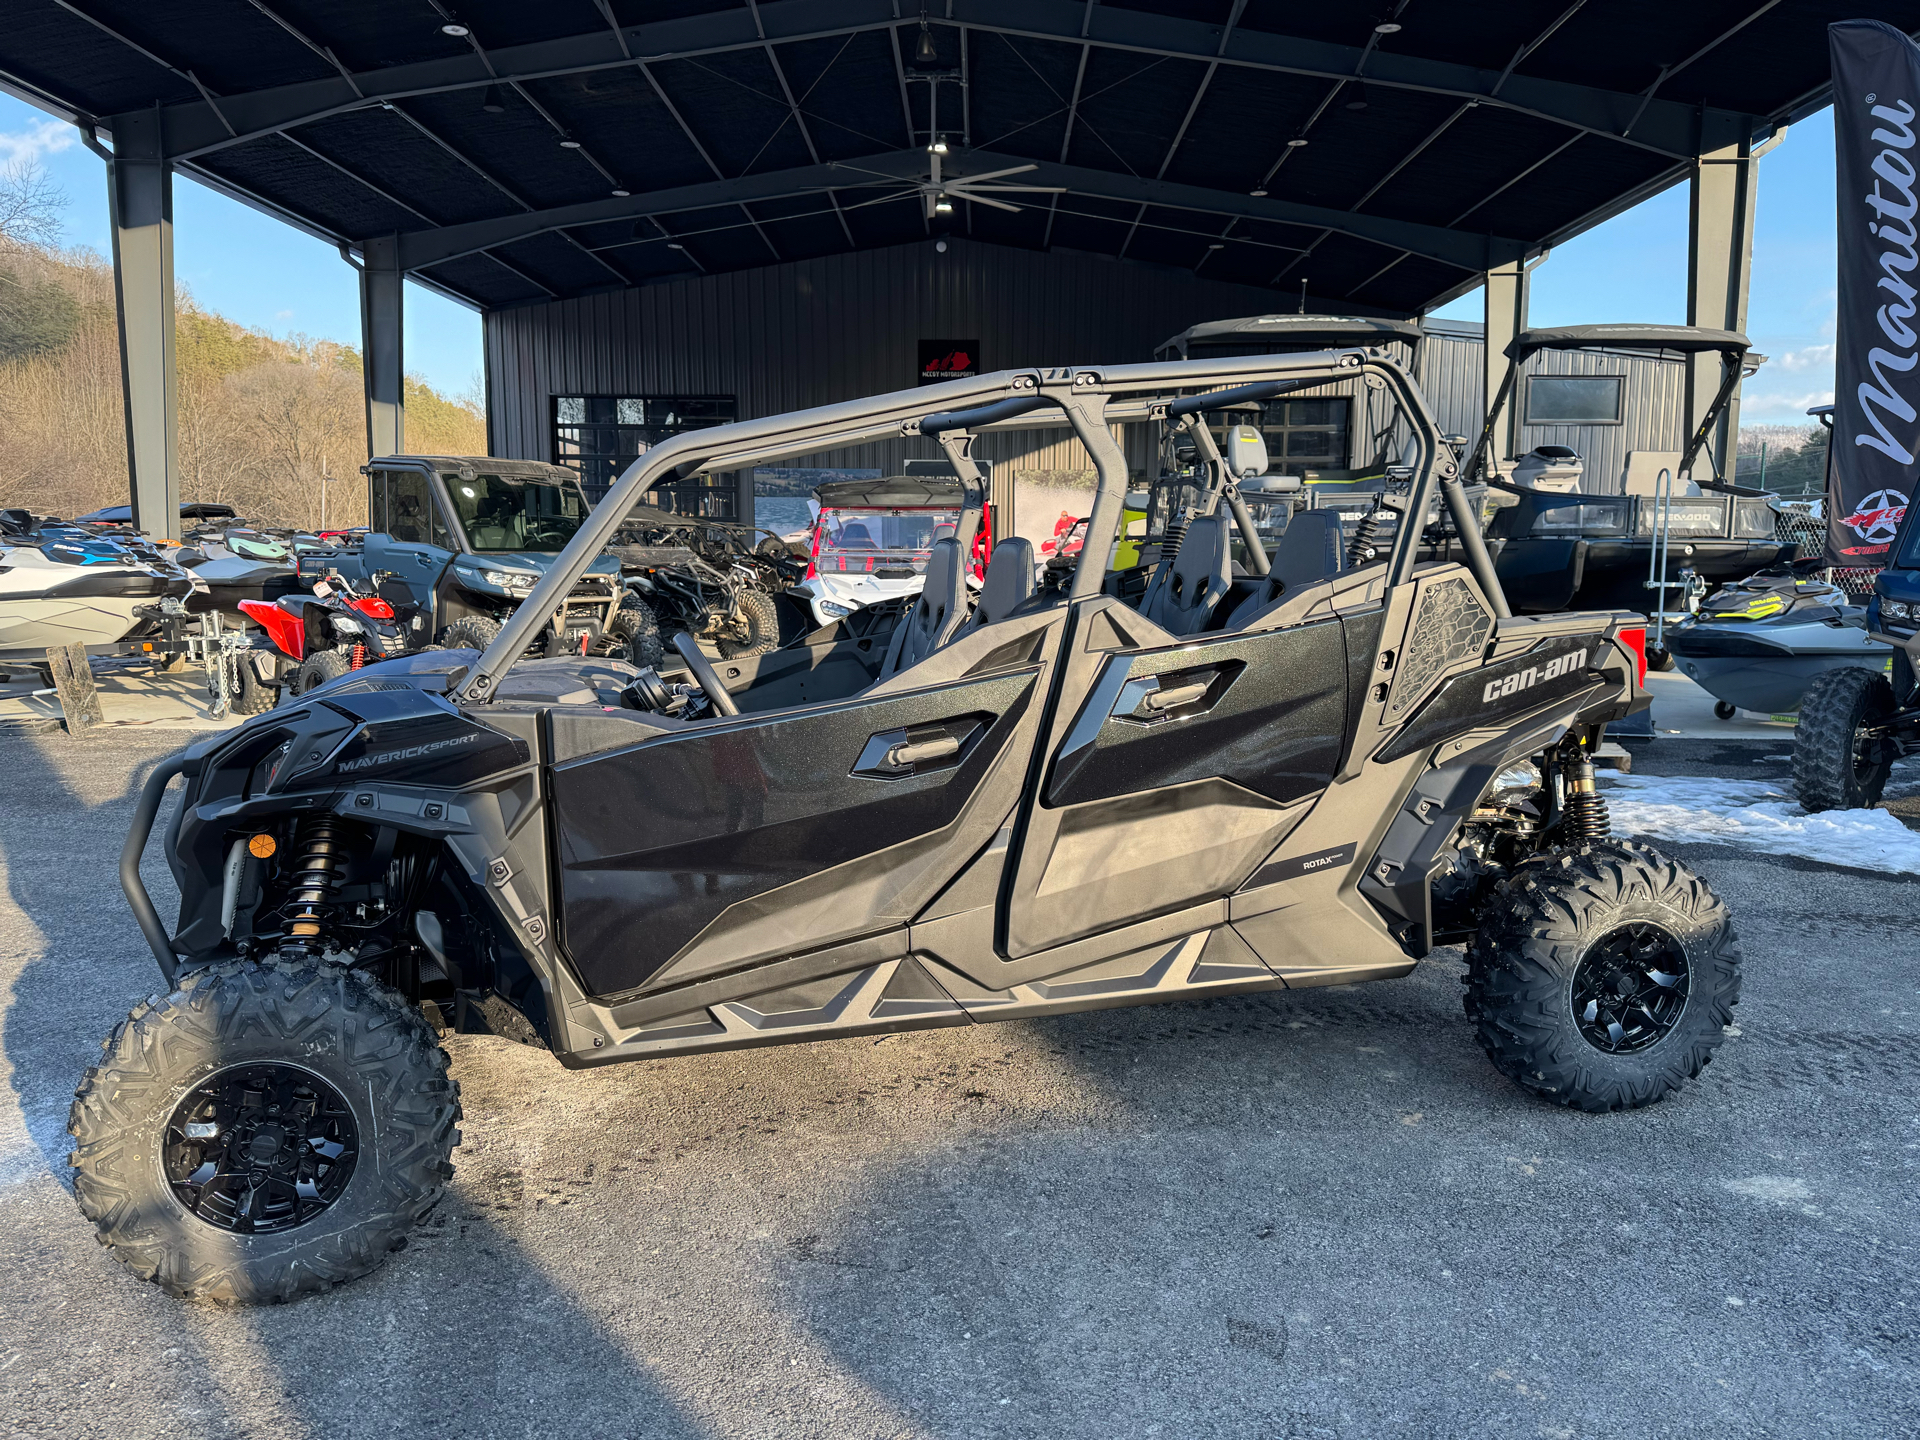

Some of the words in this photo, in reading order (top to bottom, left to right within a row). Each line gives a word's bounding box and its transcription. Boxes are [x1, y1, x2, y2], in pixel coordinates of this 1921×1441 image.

[1482, 647, 1587, 703] can-am
[338, 743, 431, 773] MAVERICK
[428, 732, 478, 751] SPORT
[1302, 855, 1333, 870] ROTAX
